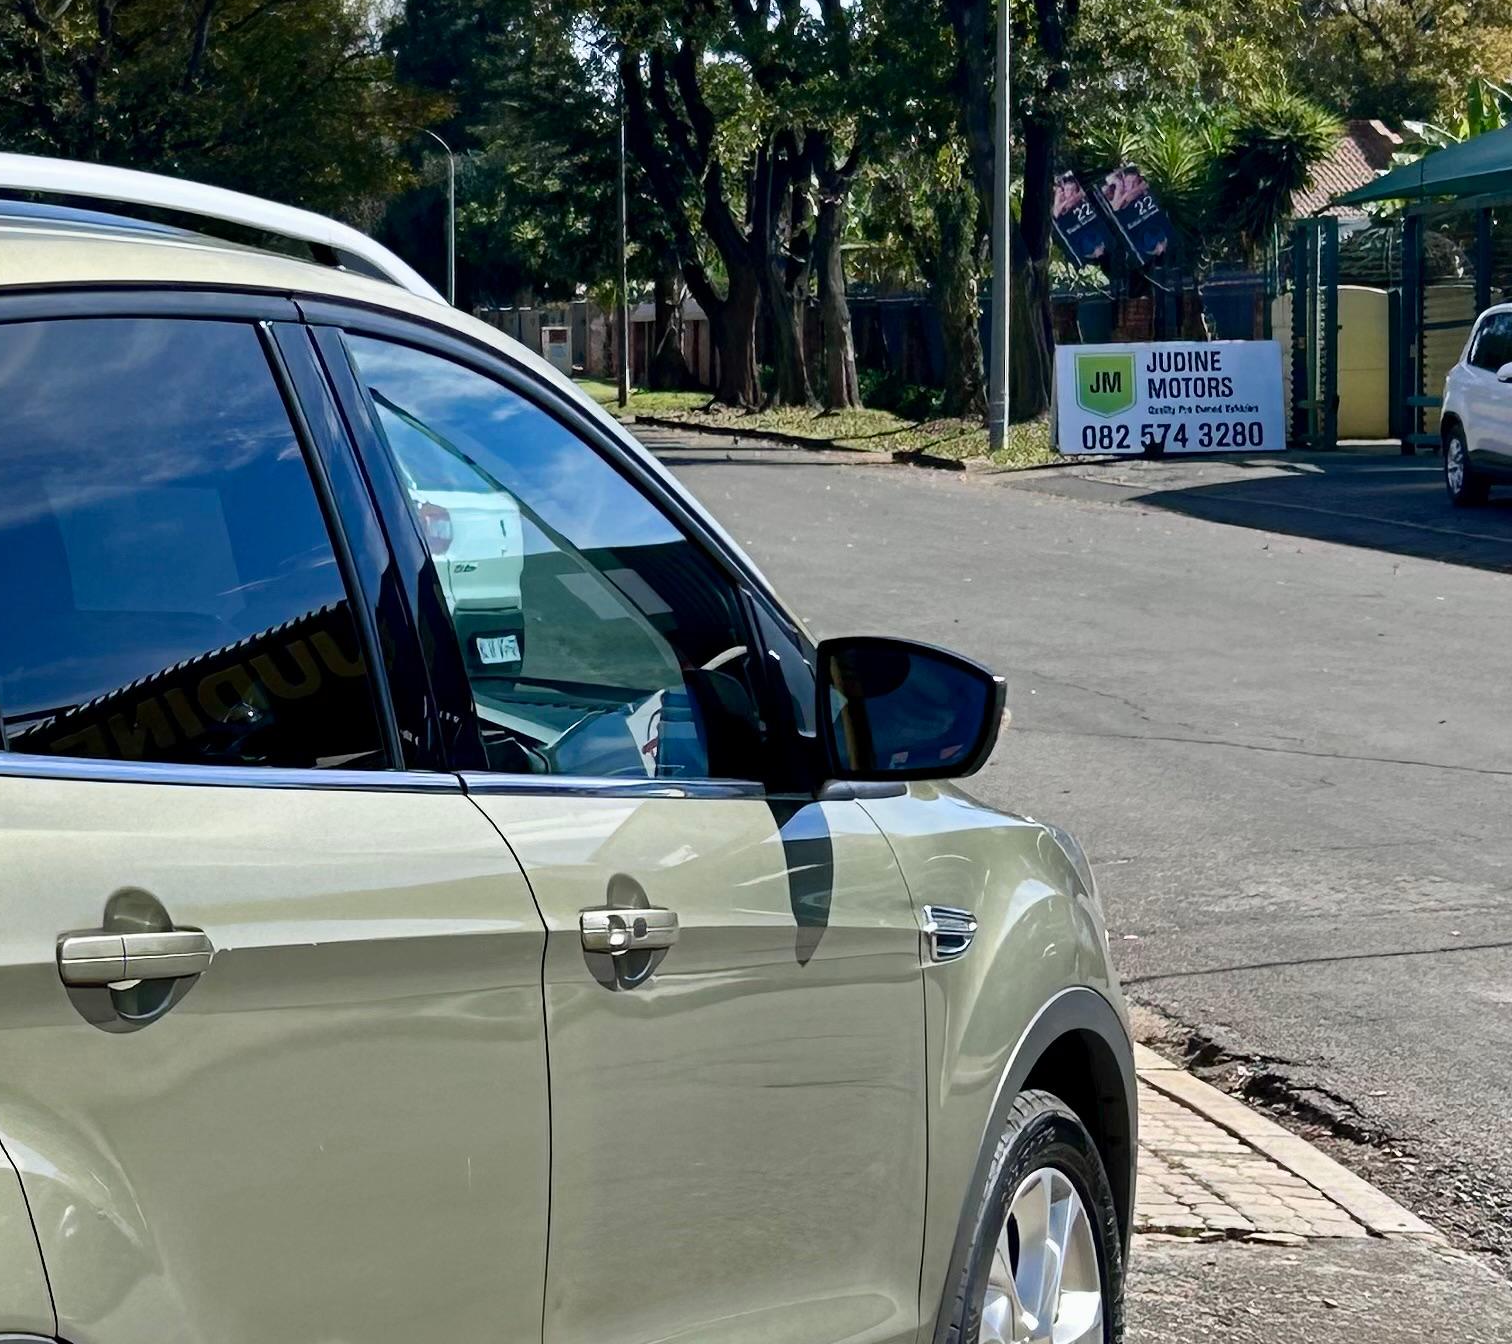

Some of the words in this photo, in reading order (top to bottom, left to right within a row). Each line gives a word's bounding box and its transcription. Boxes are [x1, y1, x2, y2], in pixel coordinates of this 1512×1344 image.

[1146, 351, 1222, 373] JUDINE
[1090, 371, 1121, 393] JM
[1147, 376, 1234, 399] MOTORS
[1082, 424, 1130, 449] 082
[1140, 423, 1188, 449] 574
[1198, 421, 1264, 447] 3280
